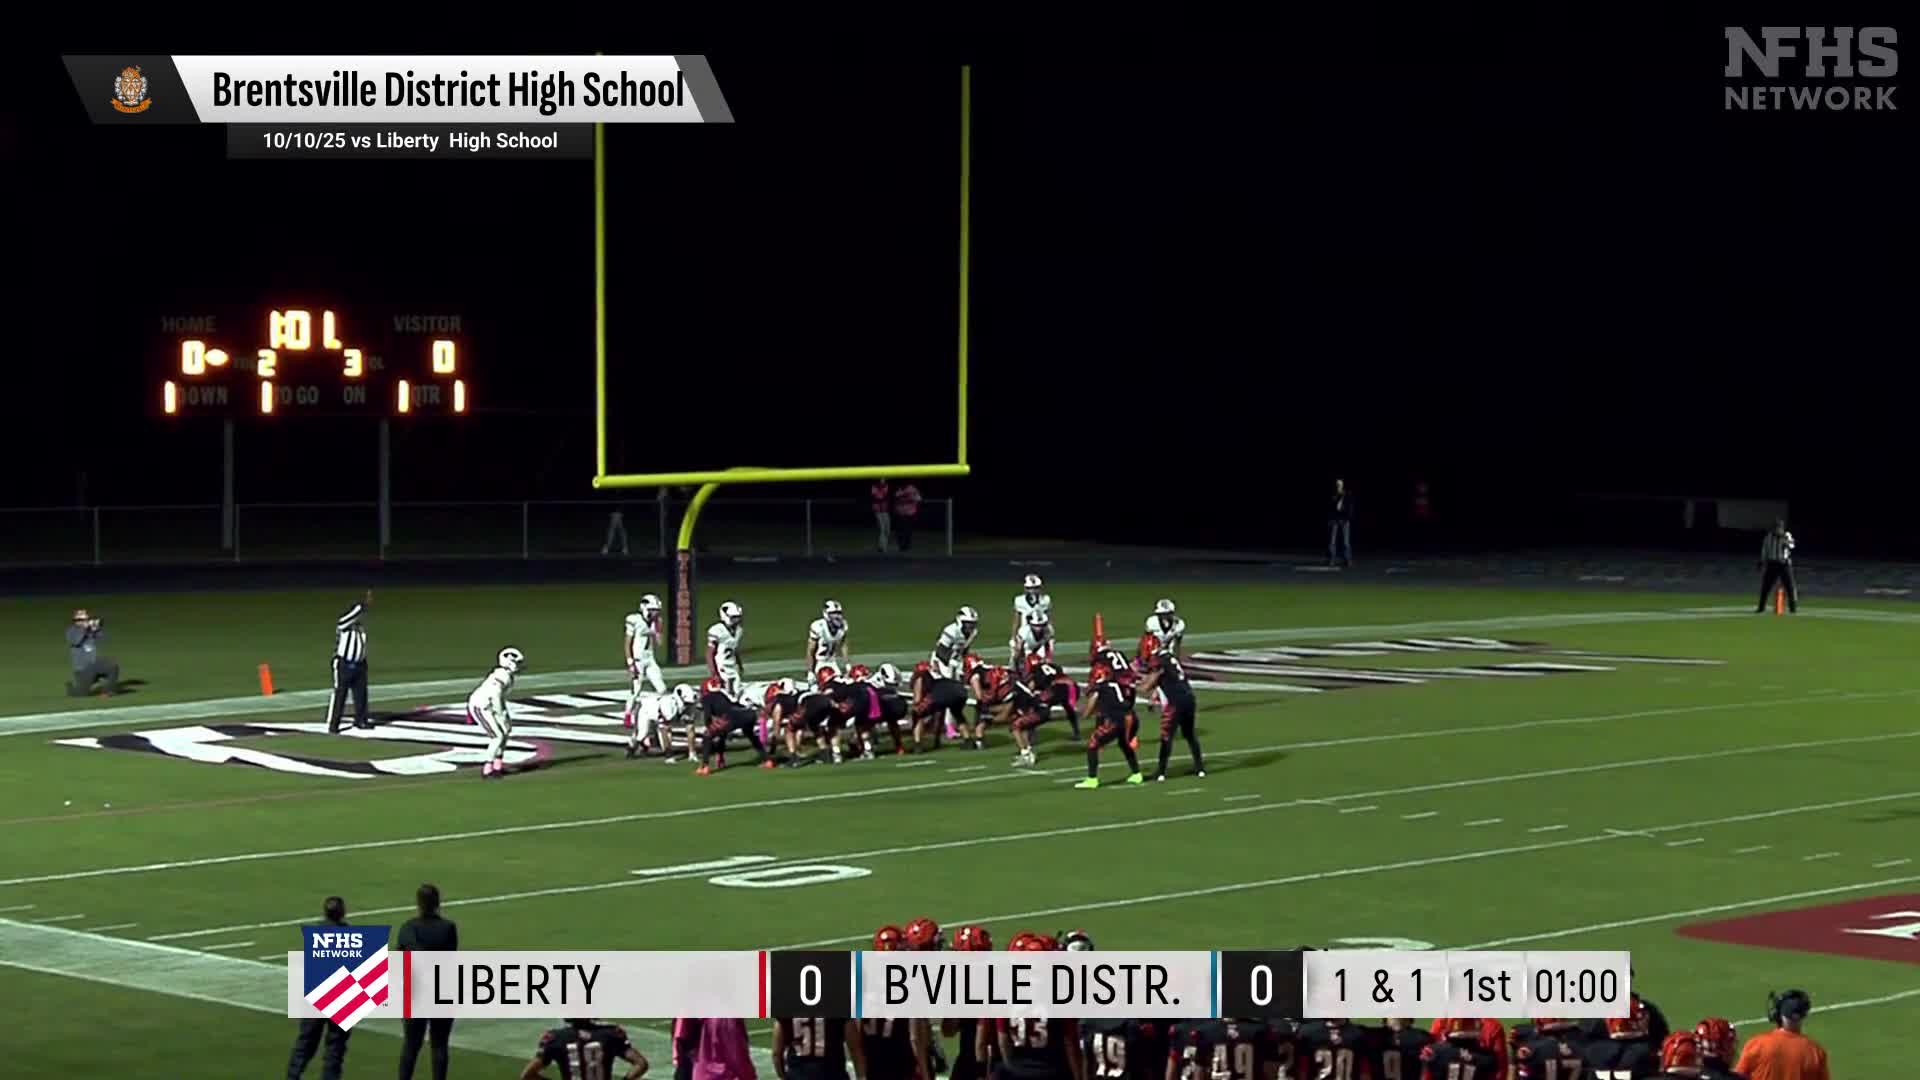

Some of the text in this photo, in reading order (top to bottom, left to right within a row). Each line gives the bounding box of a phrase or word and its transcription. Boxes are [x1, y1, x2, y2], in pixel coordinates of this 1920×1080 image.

[162, 315, 216, 335] HOME
[393, 314, 462, 334] VISITOR
[182, 340, 206, 375] 0
[257, 349, 277, 377] 2
[344, 349, 363, 376] 3
[432, 340, 456, 373] 0
[344, 386, 367, 405] ON
[1106, 651, 1129, 670] 21
[1093, 1032, 1126, 1077] 19
[1211, 1043, 1255, 1080] 49
